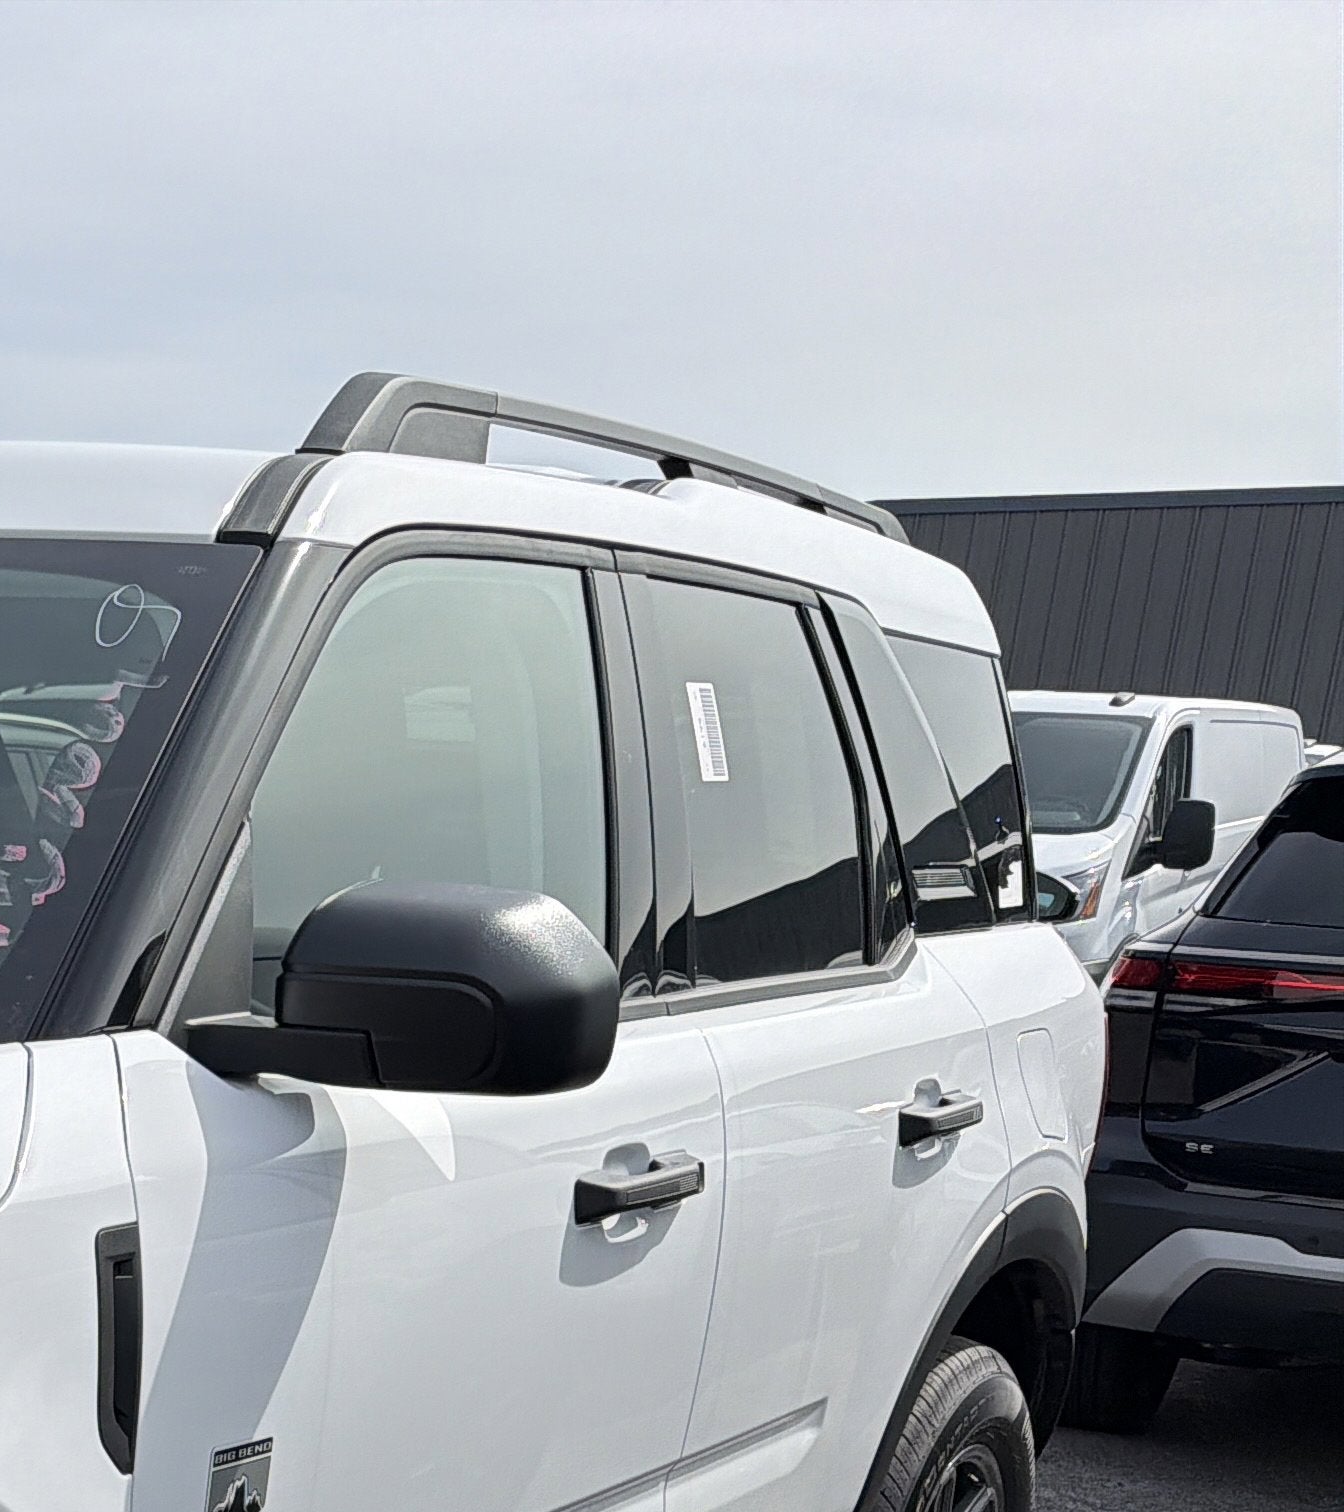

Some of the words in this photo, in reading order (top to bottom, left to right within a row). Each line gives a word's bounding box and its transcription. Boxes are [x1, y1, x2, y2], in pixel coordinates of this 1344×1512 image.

[1185, 1142, 1215, 1155] SE
[215, 1450, 236, 1465] BIG
[238, 1441, 272, 1458] BEND
